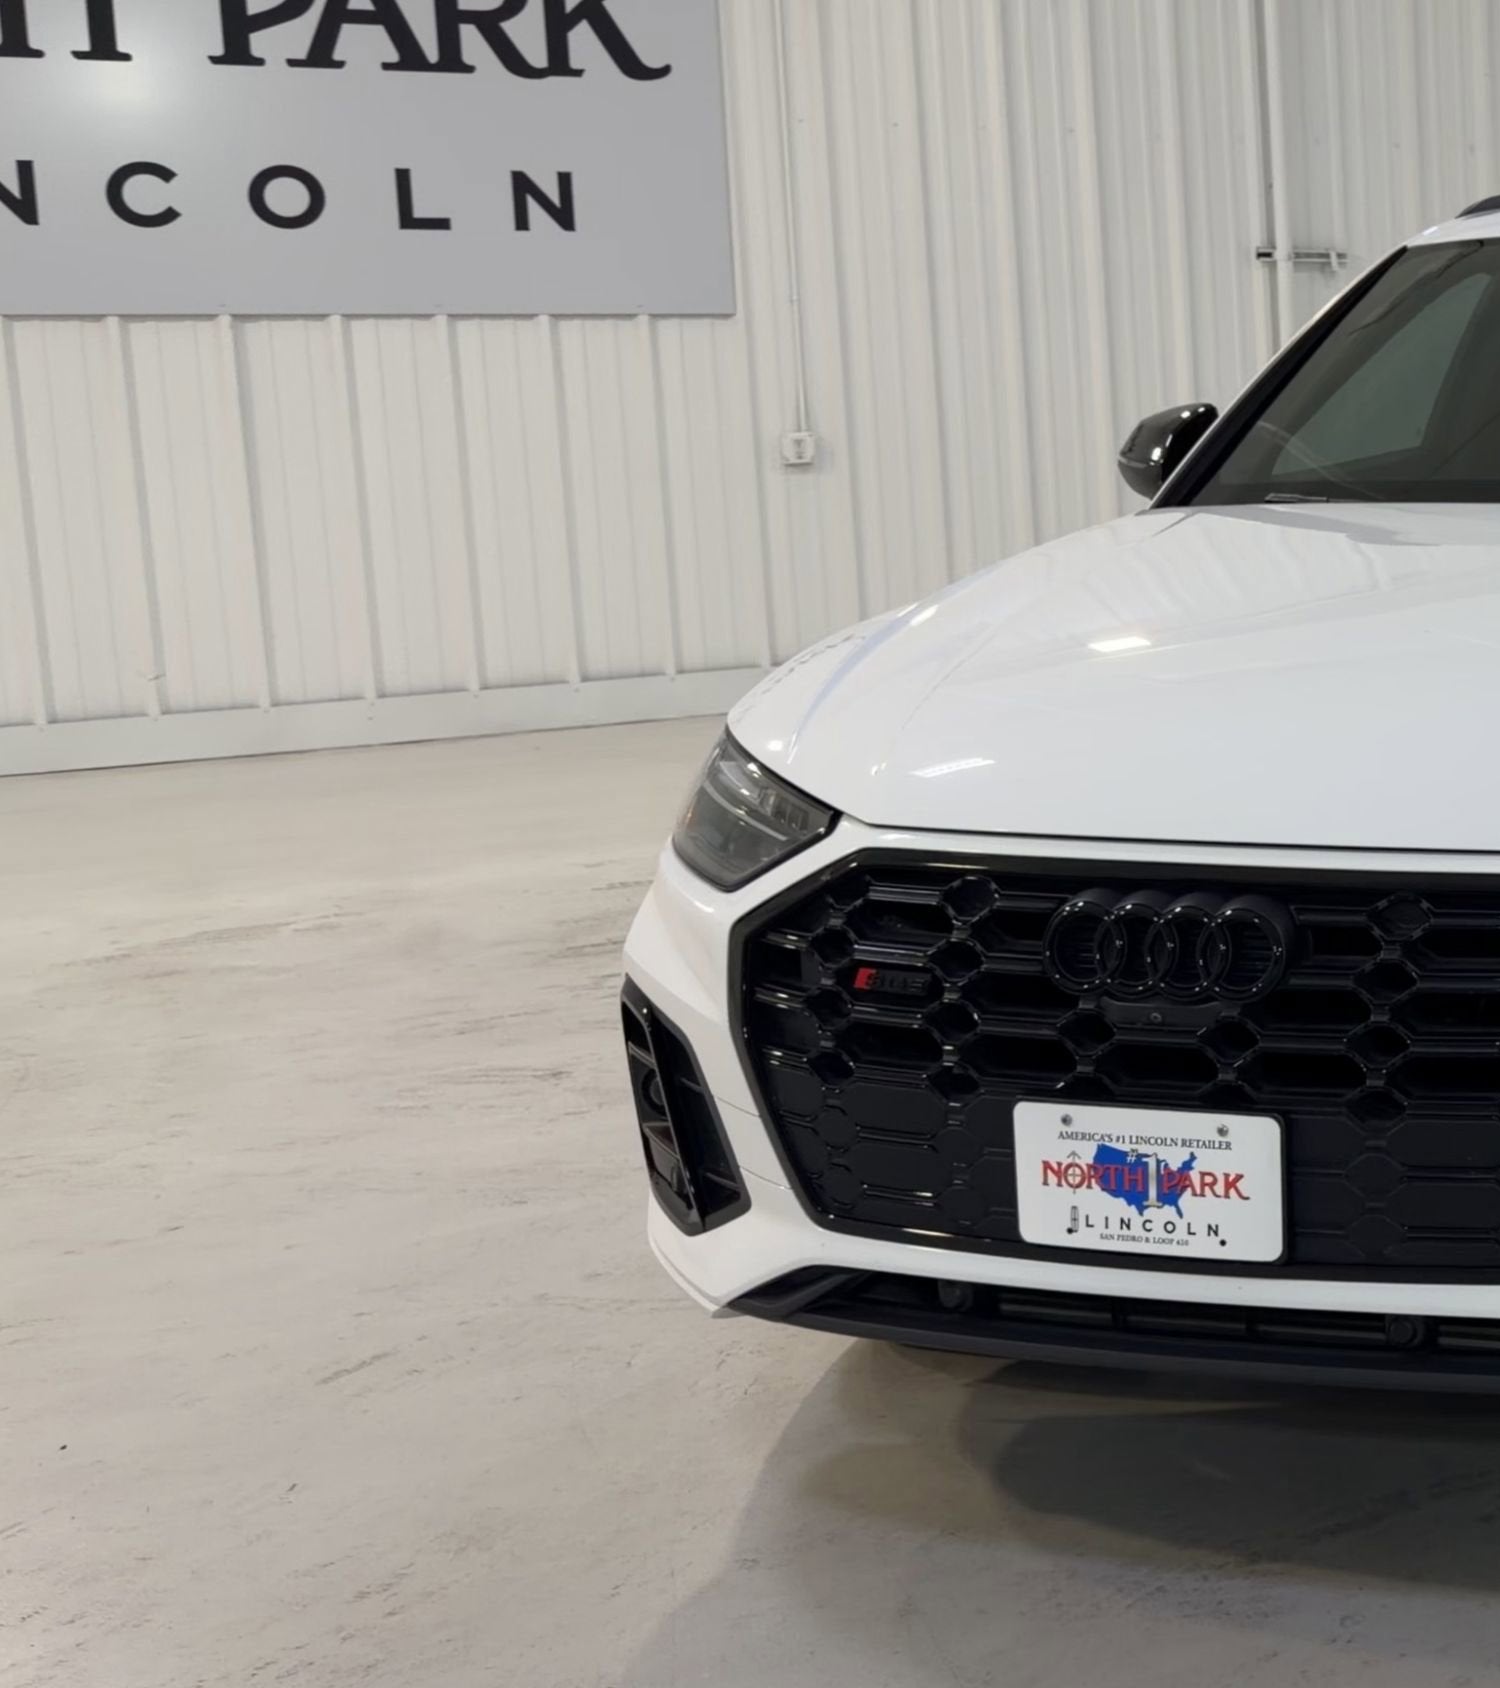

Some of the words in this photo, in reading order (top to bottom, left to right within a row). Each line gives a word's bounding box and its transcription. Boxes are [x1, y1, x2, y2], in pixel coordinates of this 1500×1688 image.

[1057, 1130, 1113, 1143] AMERICA'S
[1115, 1135, 1126, 1145] #1
[1129, 1134, 1179, 1147] LINCOLN
[1180, 1138, 1233, 1151] RETAILER
[1041, 1159, 1145, 1192] NORTH
[1162, 1167, 1251, 1201] PARK
[1085, 1214, 1220, 1237] LINCOLN
[1099, 1233, 1115, 1241] SAN
[1117, 1234, 1143, 1243] PEDRO
[1153, 1237, 1175, 1245] LOOP
